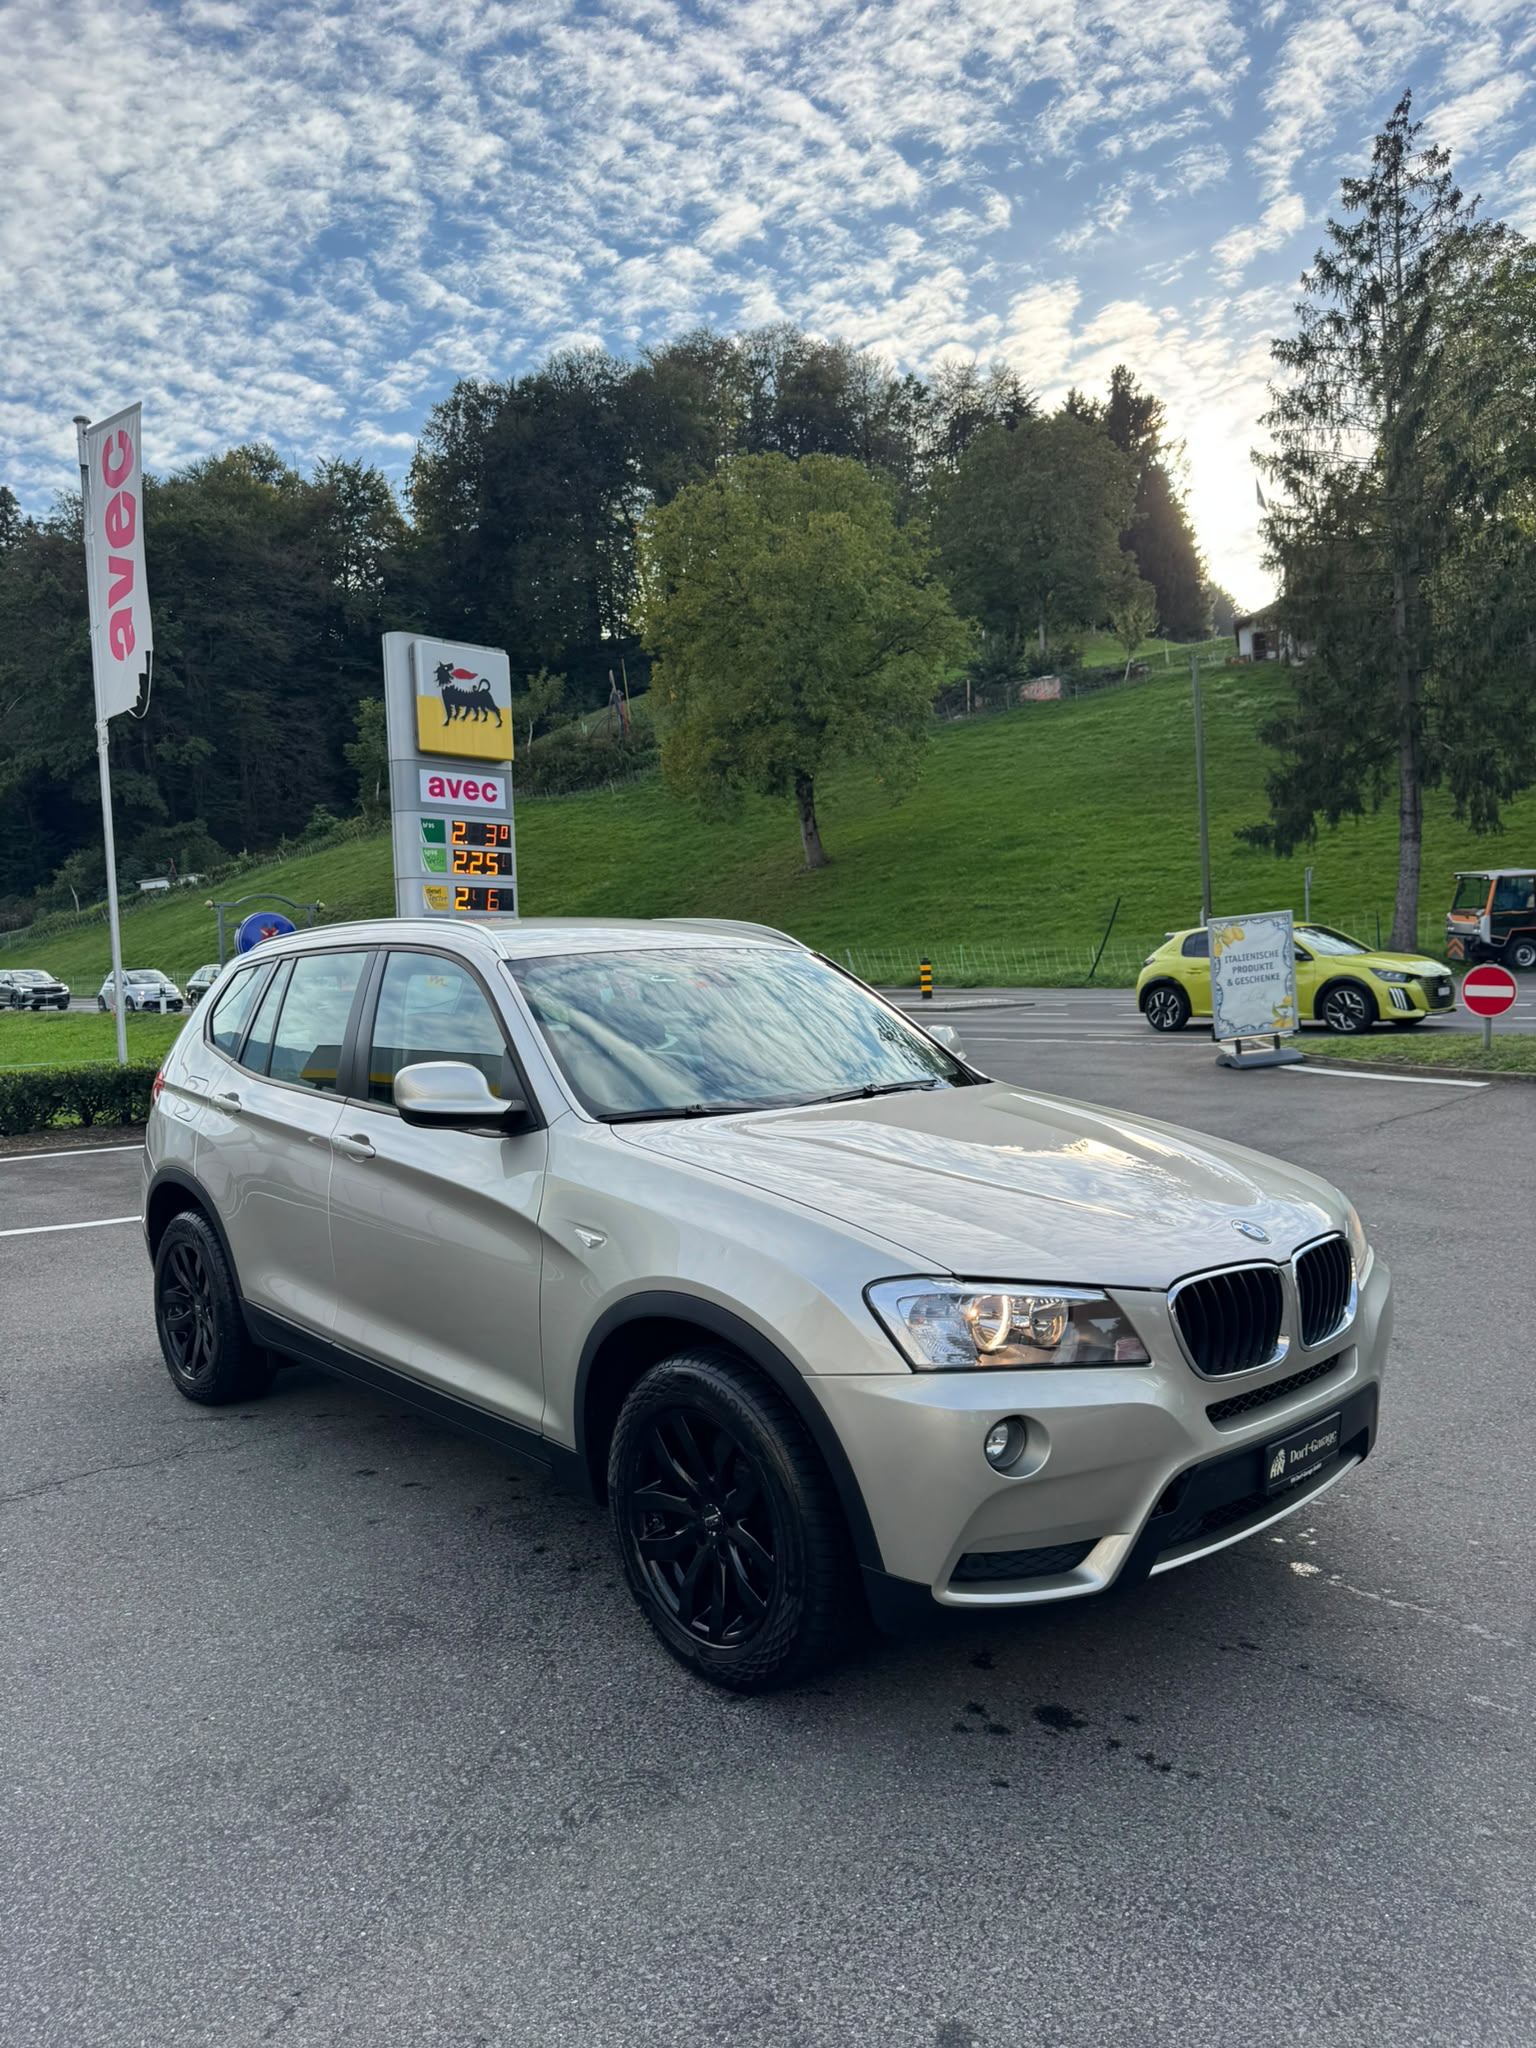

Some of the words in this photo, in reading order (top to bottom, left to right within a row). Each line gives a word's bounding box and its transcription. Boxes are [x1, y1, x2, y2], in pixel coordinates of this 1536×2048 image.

[102, 430, 136, 661] avec
[428, 775, 498, 803] avec
[1224, 949, 1280, 964] ITALIENISCHE
[1231, 961, 1274, 974] PRODUKTE
[1226, 978, 1233, 987] &
[1234, 972, 1281, 986] GESCHENKE
